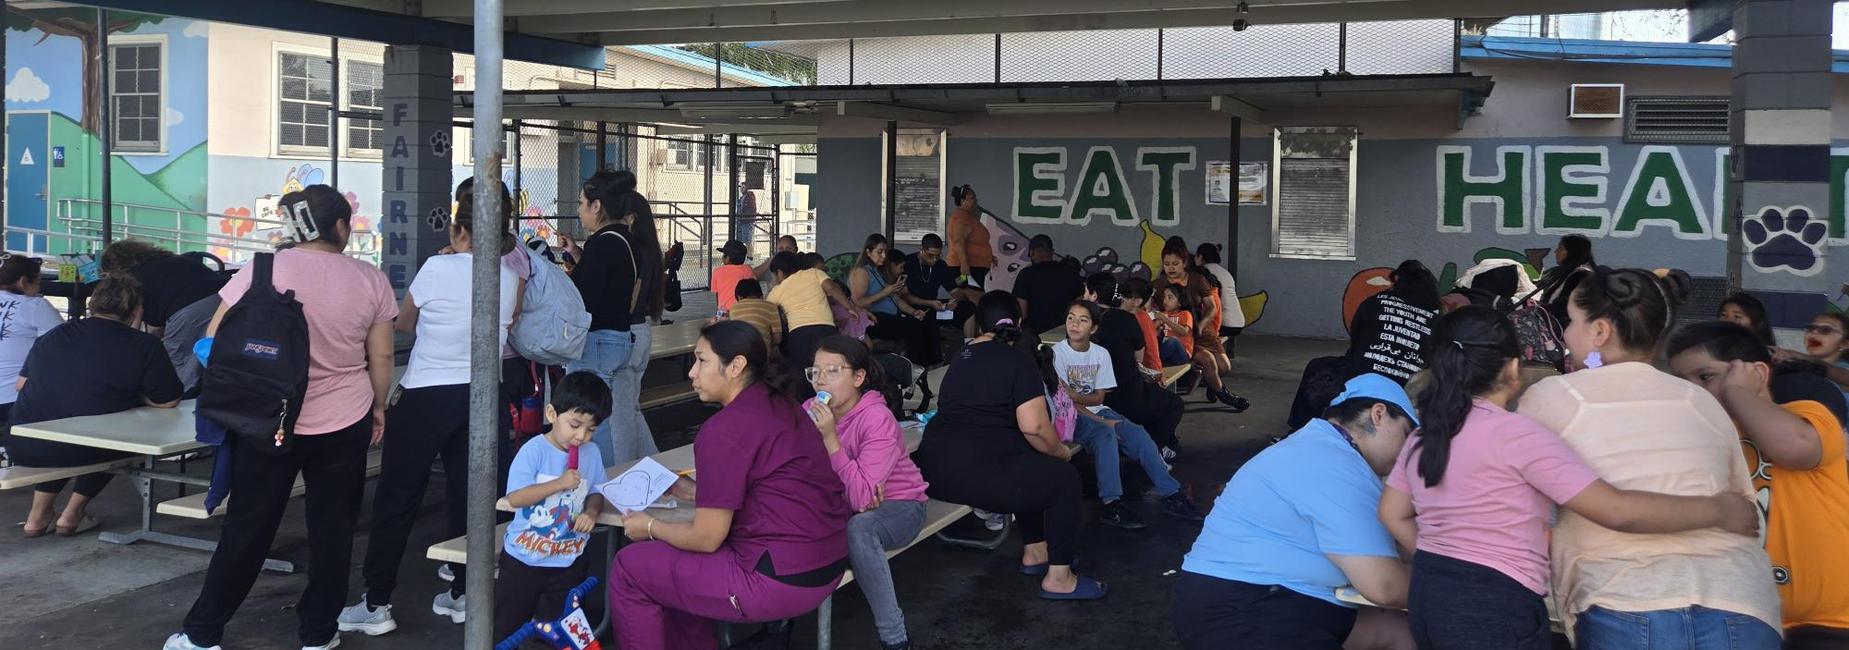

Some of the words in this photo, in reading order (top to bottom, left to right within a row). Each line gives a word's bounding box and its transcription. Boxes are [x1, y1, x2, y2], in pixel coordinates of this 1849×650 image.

[390, 103, 409, 291] FAIRNE
[1012, 146, 1196, 226] EAT
[1436, 145, 1849, 240] HEA
[1378, 314, 1403, 325] GETTING
[1405, 319, 1432, 336] RESTLESS
[1383, 306, 1395, 314] THE
[1396, 308, 1415, 319] YOUTH
[1415, 315, 1427, 324] ARE
[1383, 323, 1392, 331] LA
[513, 528, 585, 556] MICKEY
